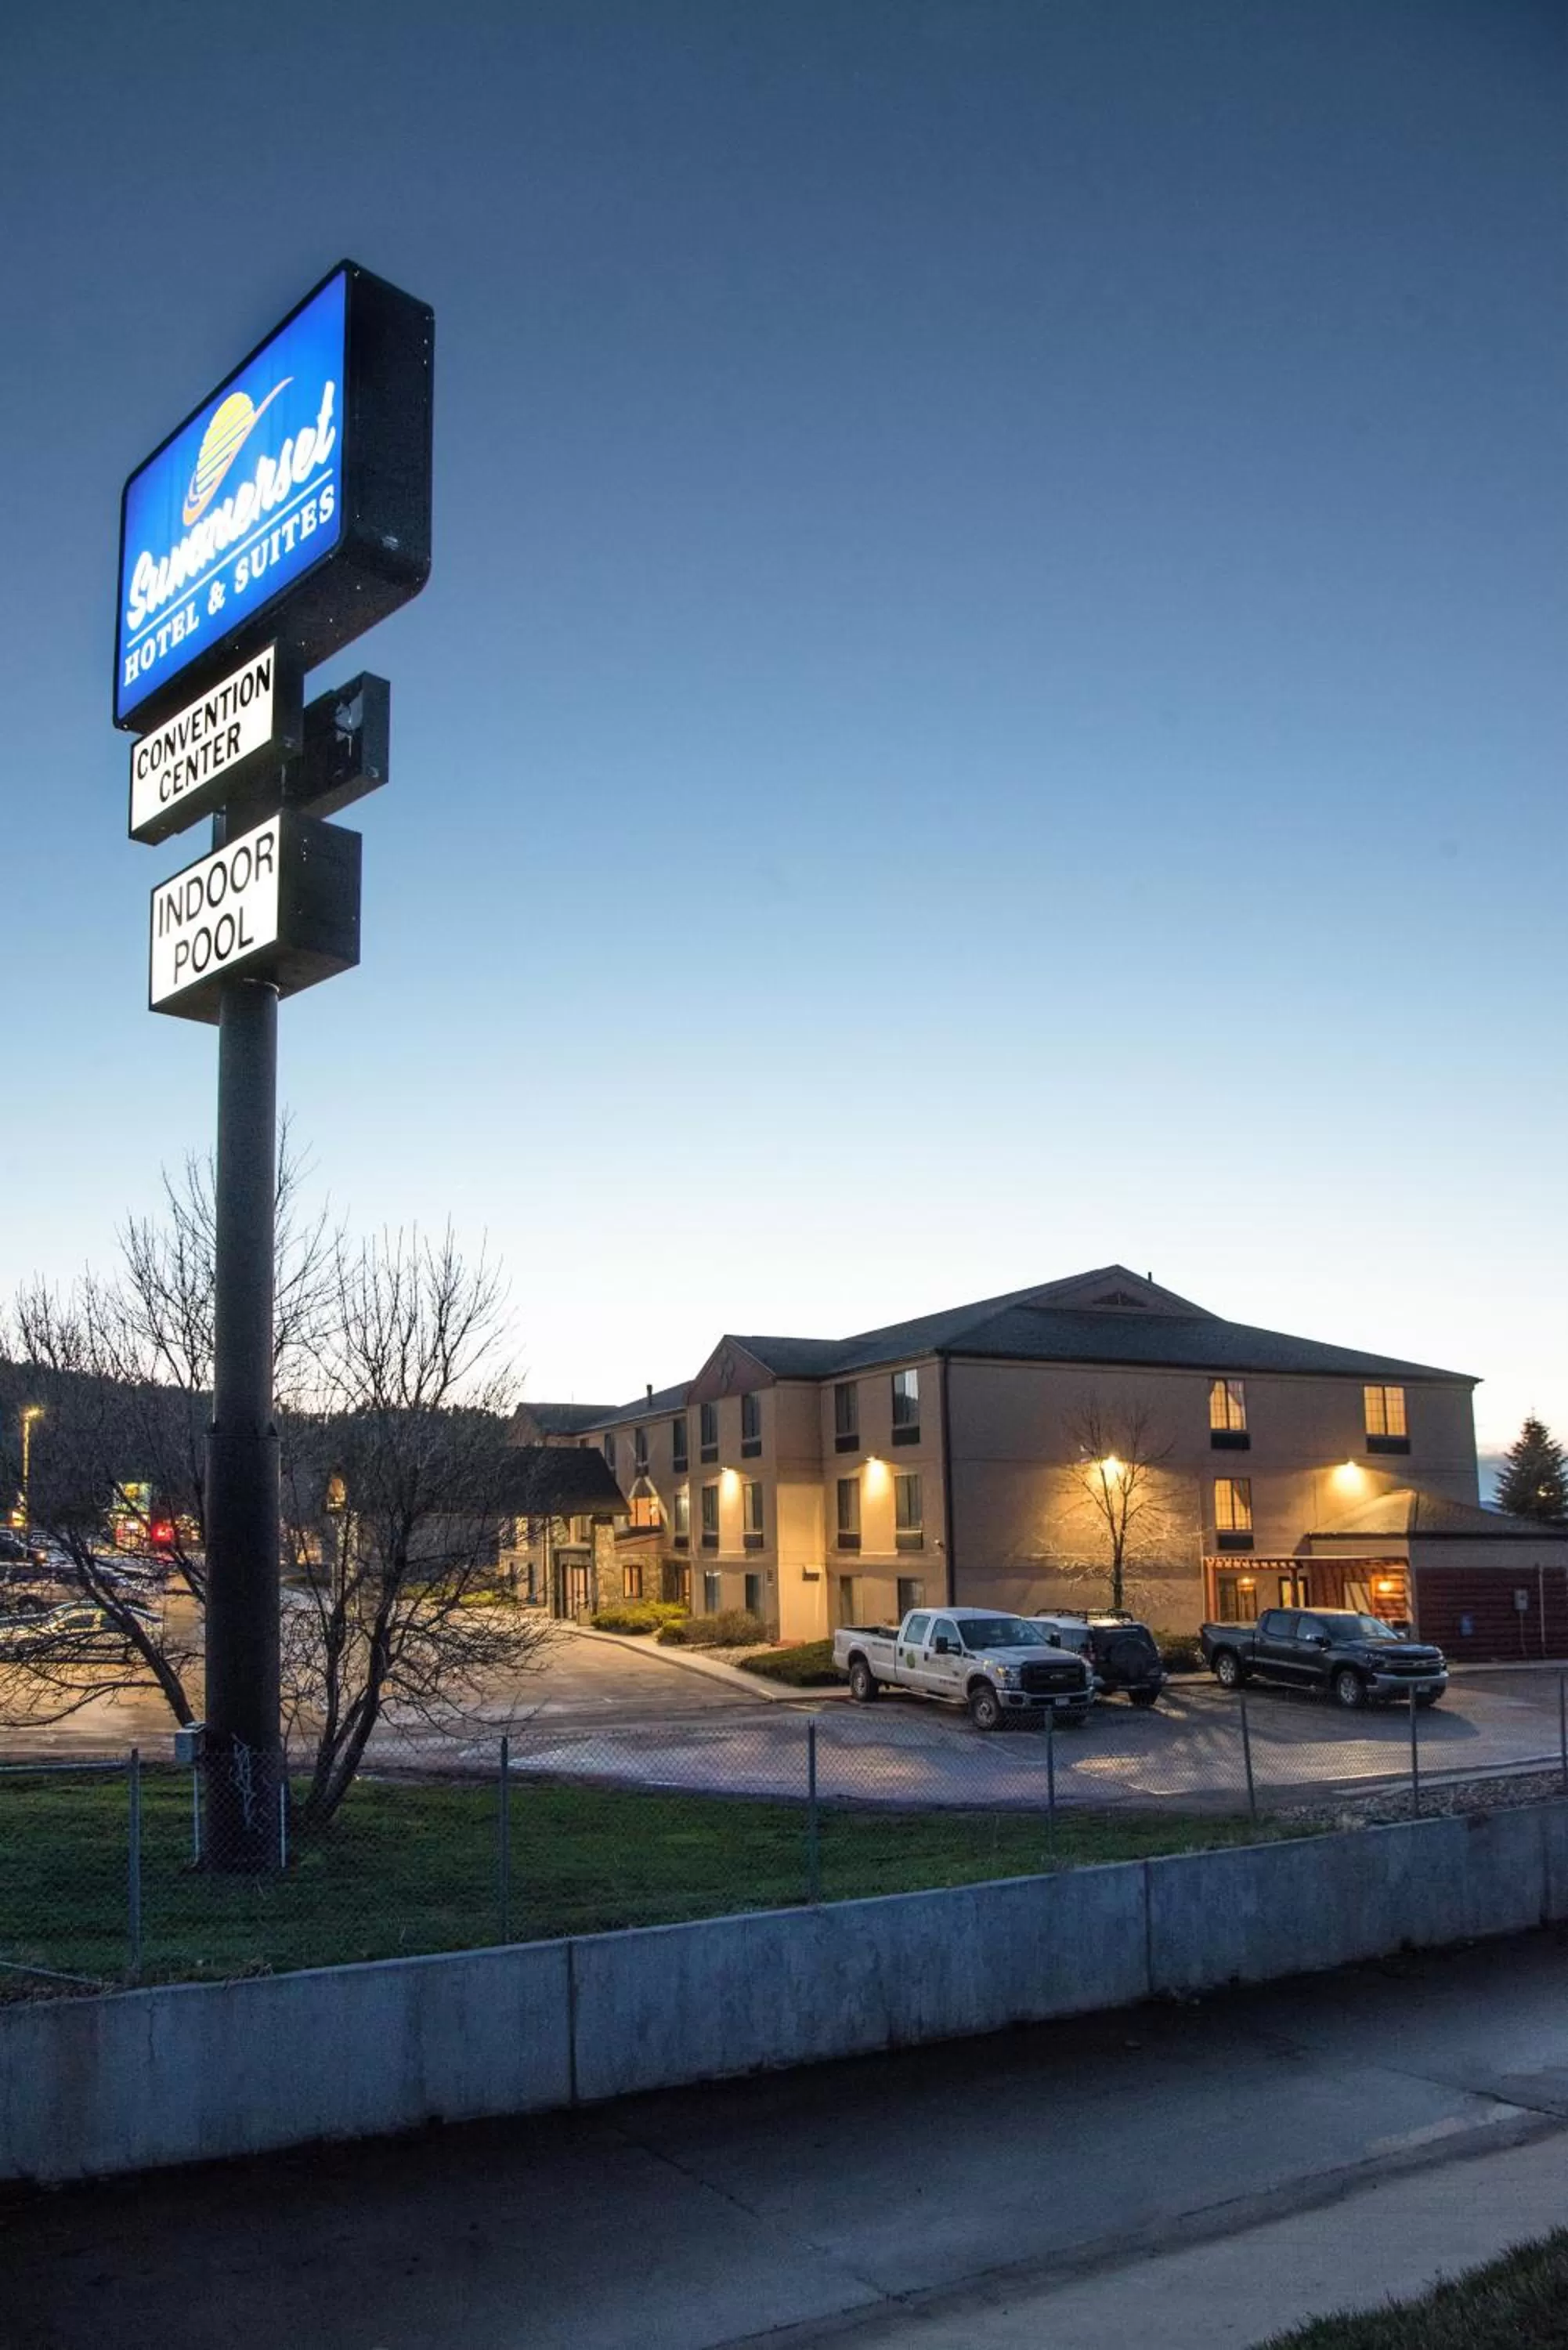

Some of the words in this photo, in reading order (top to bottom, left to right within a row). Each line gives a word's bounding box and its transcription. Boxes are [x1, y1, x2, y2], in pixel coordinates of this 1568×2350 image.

[126, 381, 336, 630] Summerset
[124, 601, 200, 686] HOTEL
[208, 580, 226, 615] &
[234, 484, 335, 594] SUITES
[136, 657, 271, 780] CONVENTION
[159, 722, 242, 803] CENTER
[159, 831, 275, 938] INDOOR
[174, 906, 255, 985] POOL
